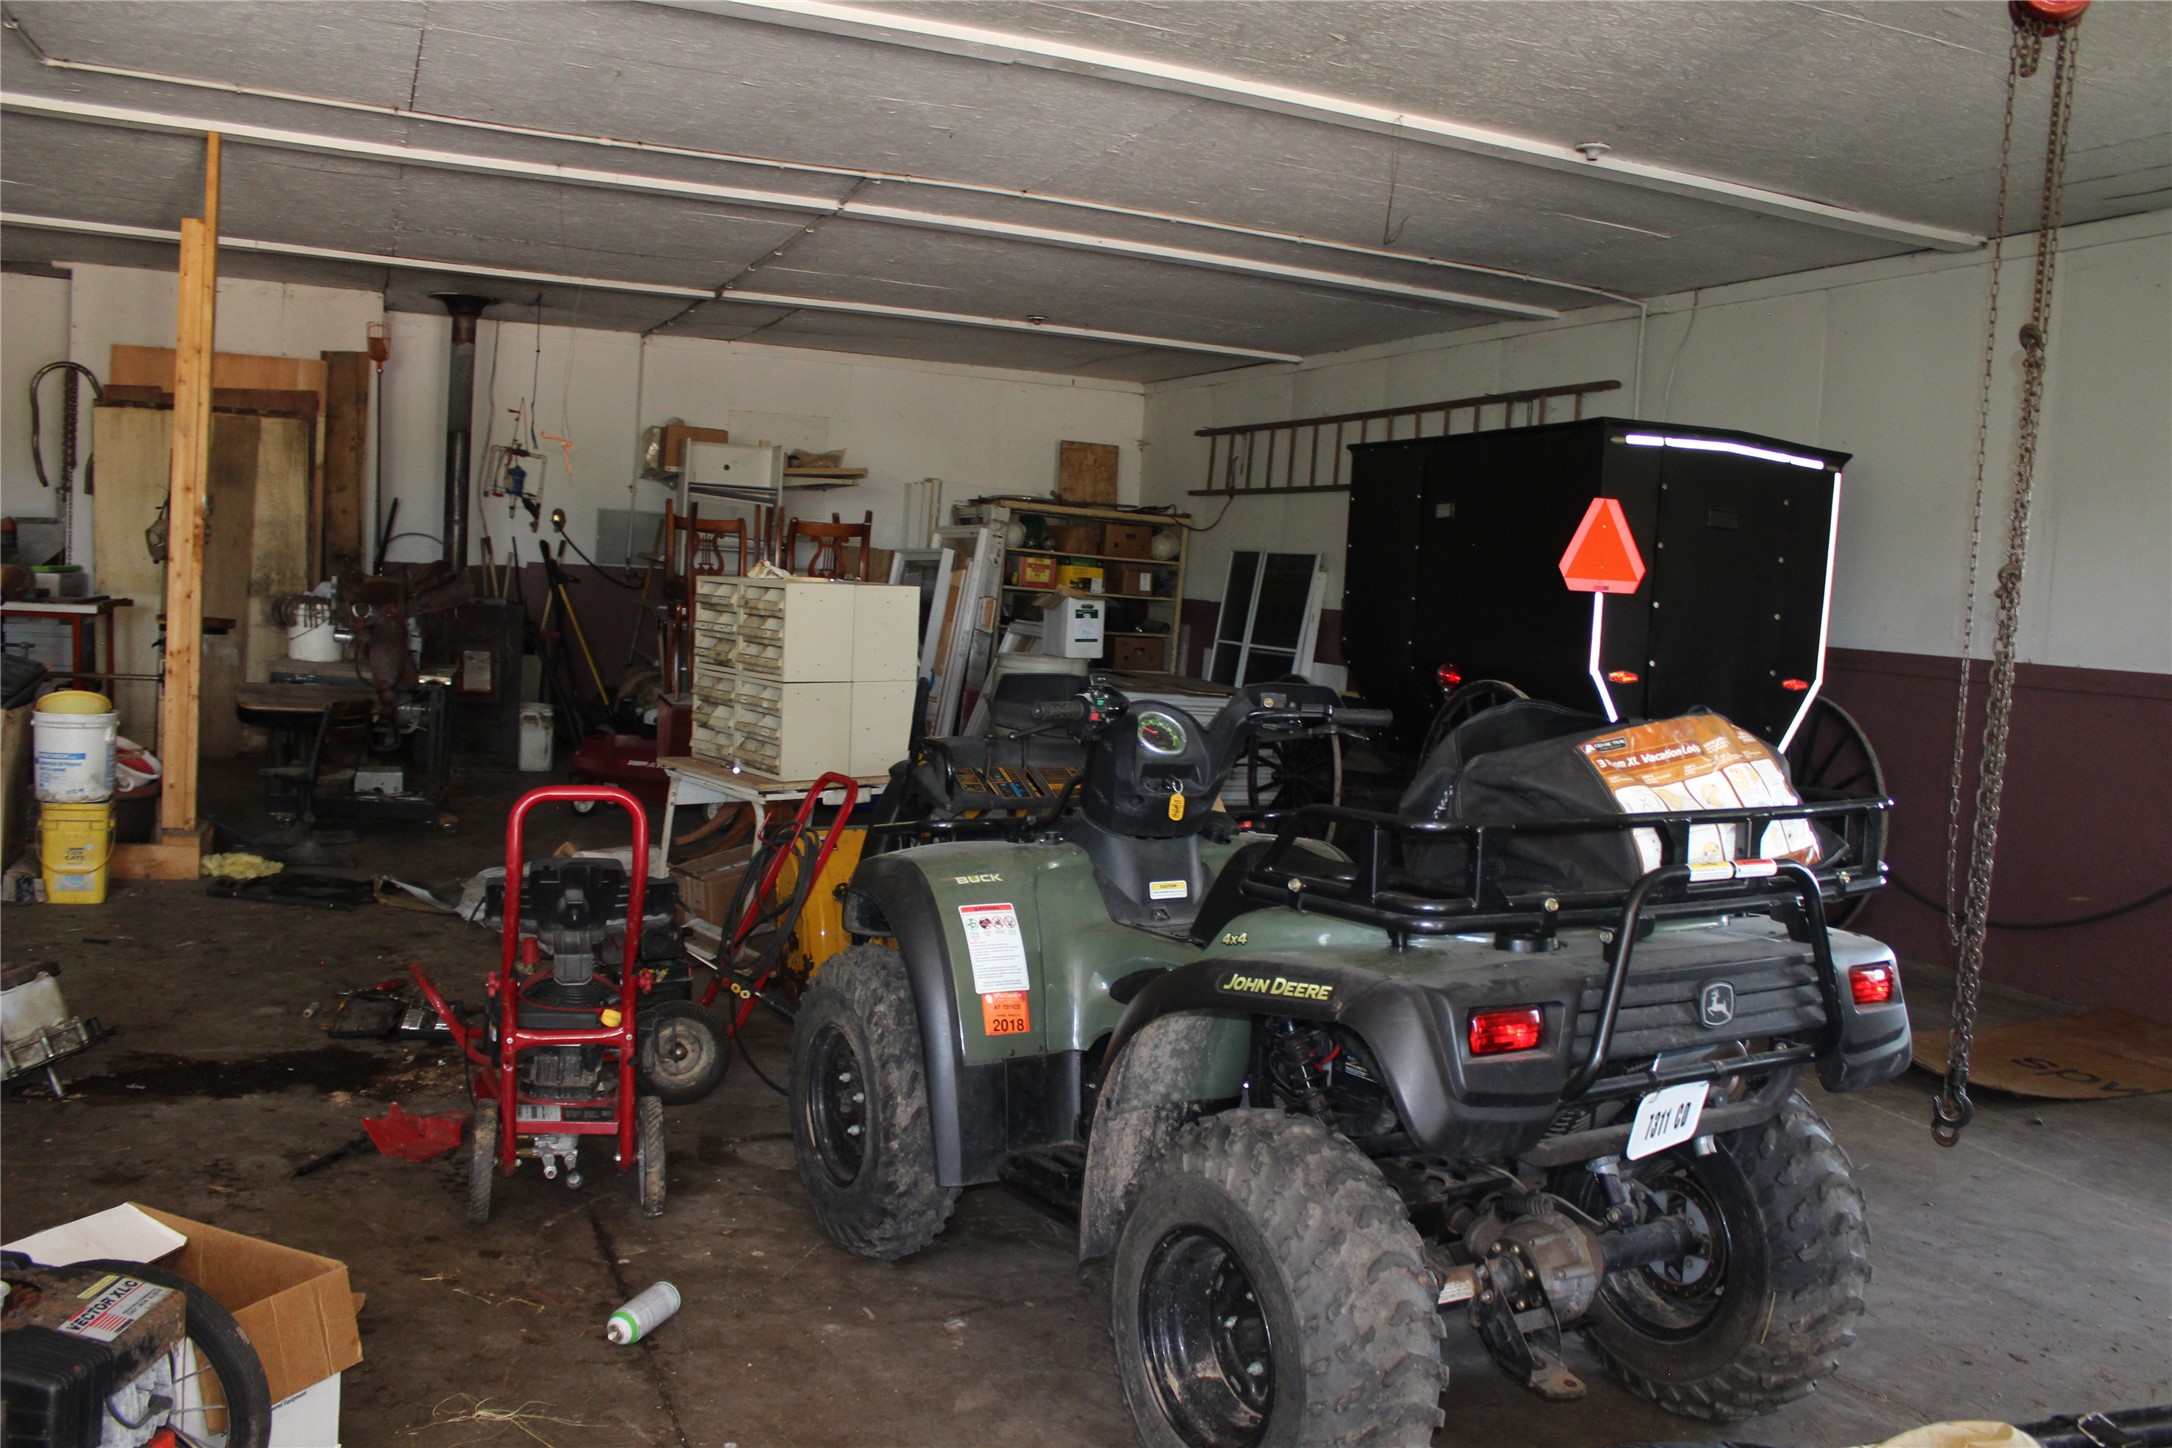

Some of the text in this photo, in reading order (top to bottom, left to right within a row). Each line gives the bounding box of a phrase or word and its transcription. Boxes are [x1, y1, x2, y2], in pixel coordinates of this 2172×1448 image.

[1597, 758, 1606, 768] 3
[1627, 756, 1640, 767] XL
[1640, 748, 1682, 764] Vacation
[954, 873, 1003, 885] BUCK
[1221, 932, 1248, 945] 4x4
[1223, 973, 1333, 1000] JOHN DEERE
[992, 1018, 1025, 1032] 2018
[1644, 1101, 1692, 1140] 7311 CD
[67, 1297, 116, 1331] VECTOR
[109, 1279, 138, 1299] XLC
